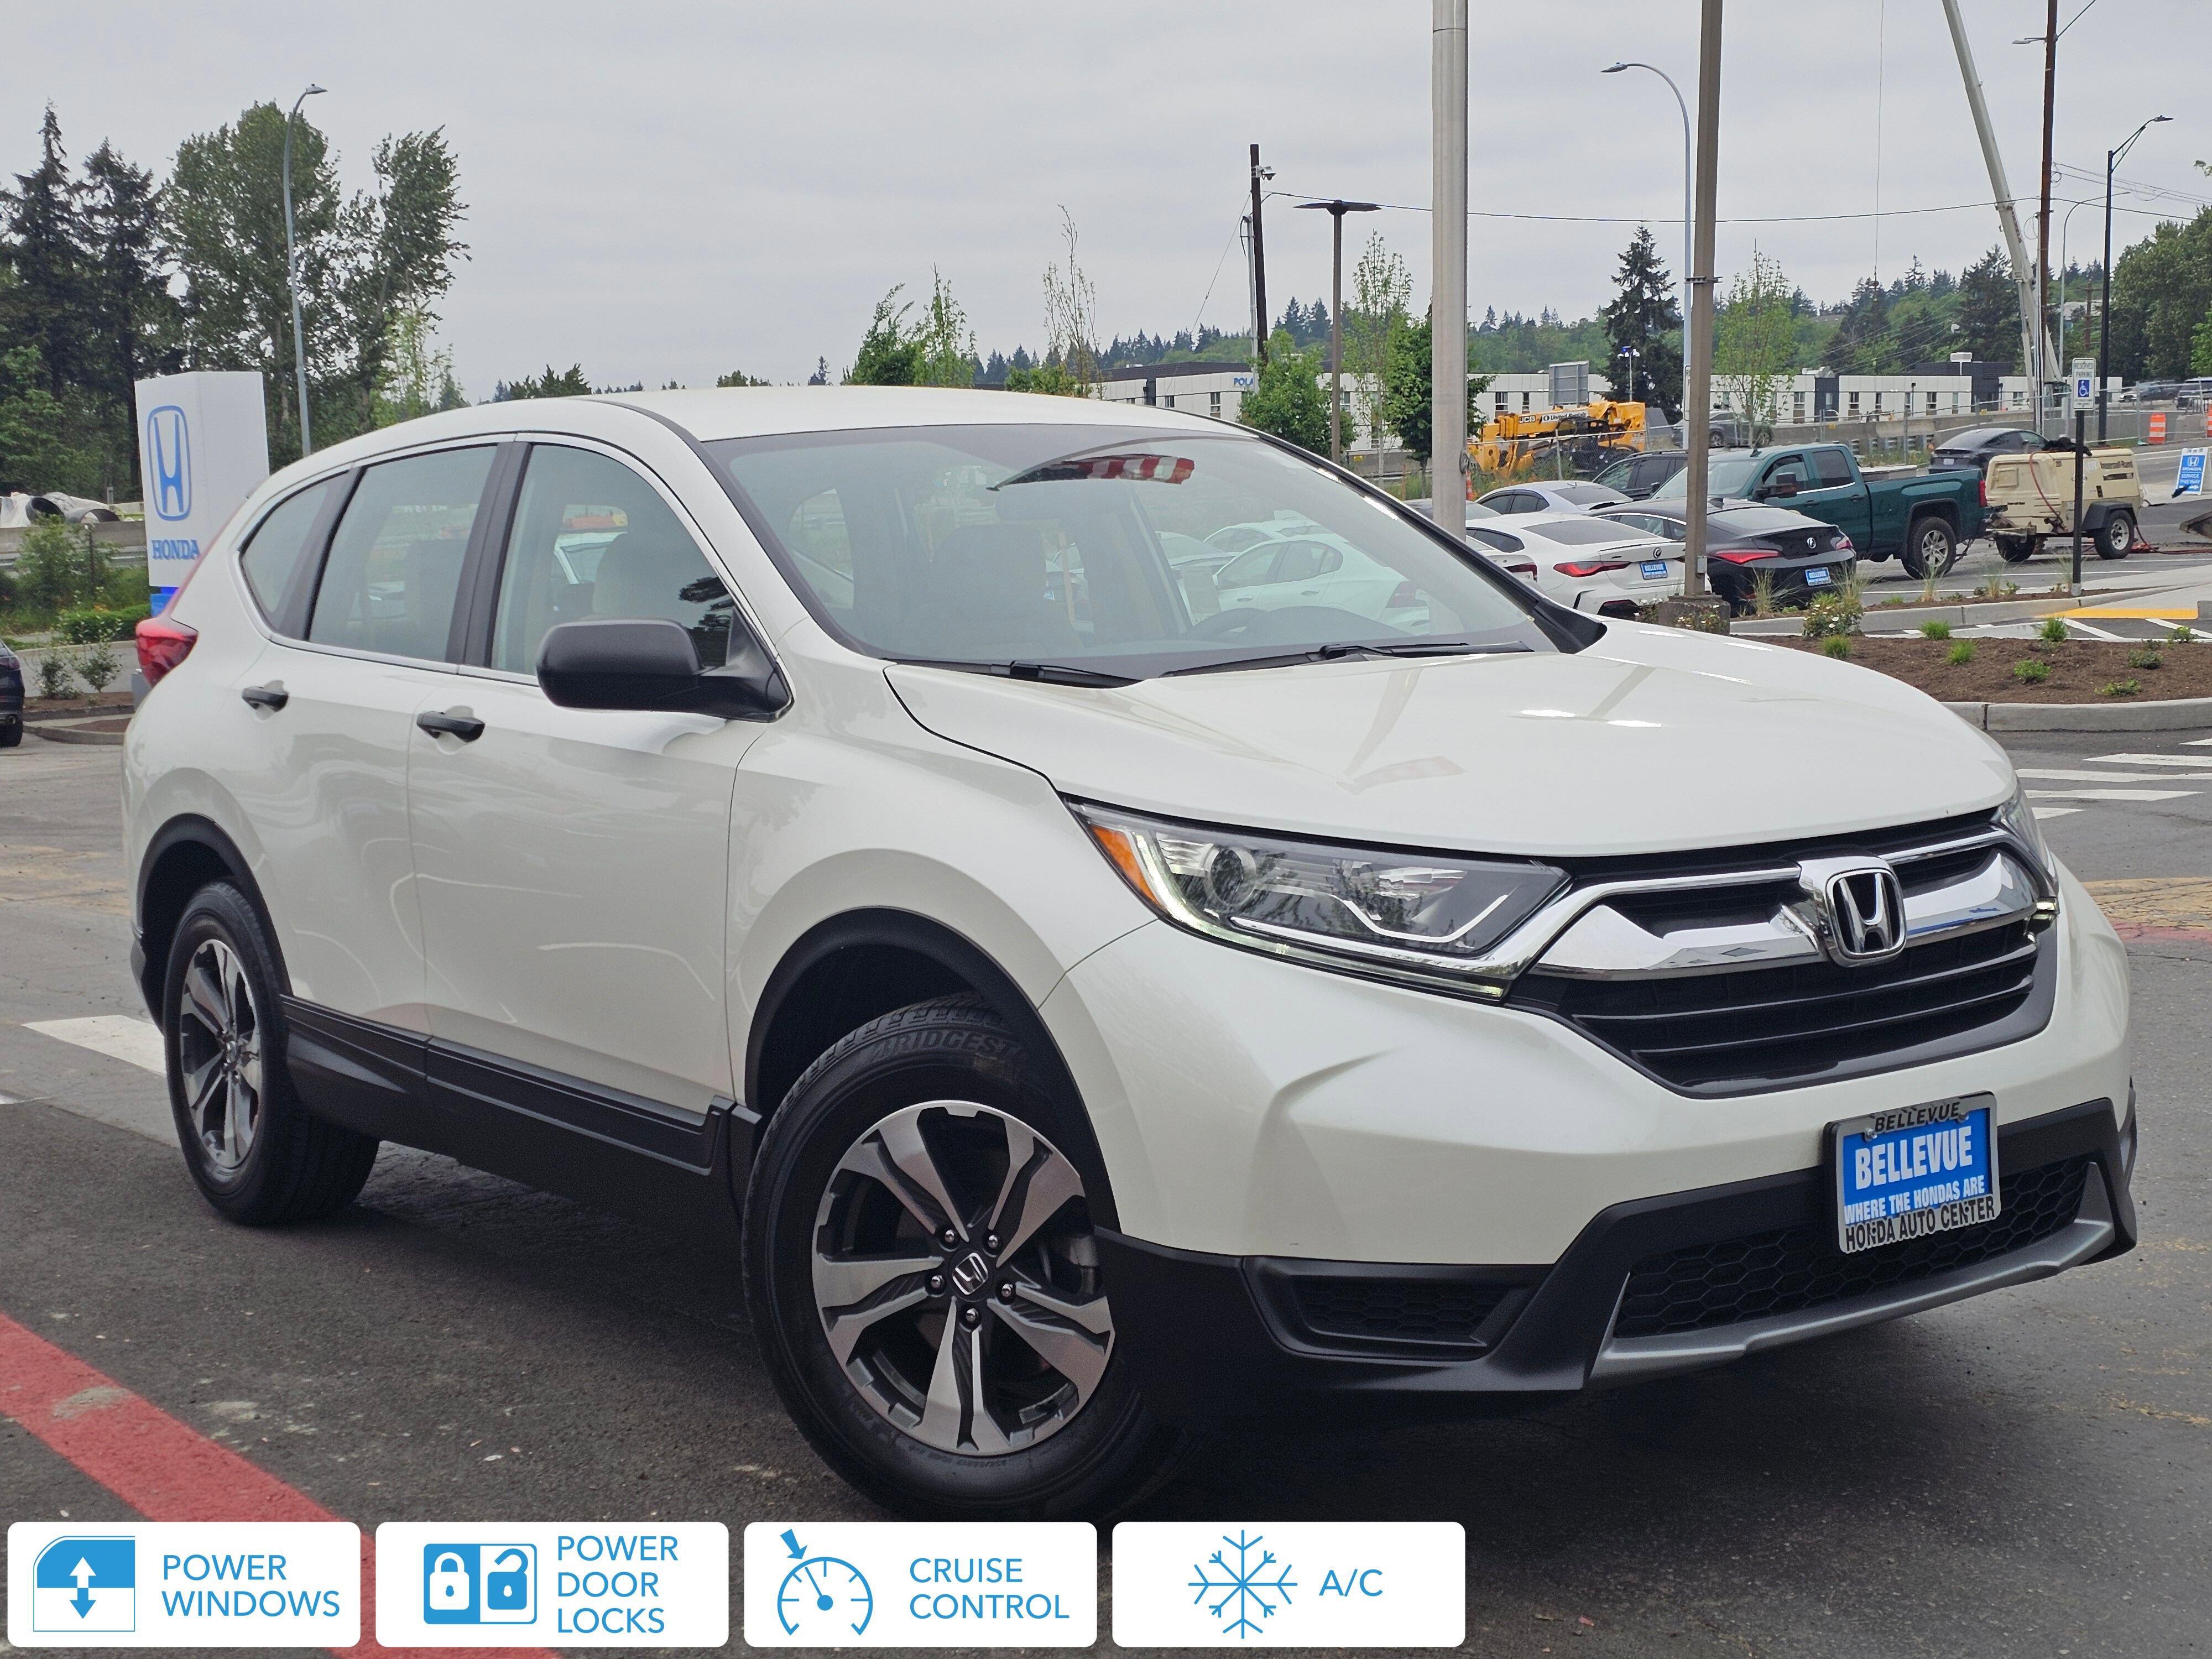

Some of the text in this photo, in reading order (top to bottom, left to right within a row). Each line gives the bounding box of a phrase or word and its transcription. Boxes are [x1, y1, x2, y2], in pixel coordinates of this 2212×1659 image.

[152, 539, 201, 560] HONDA
[1875, 1102, 1960, 1133] BELLEVUE
[1855, 1126, 1973, 1190] BELLEVUE
[1844, 1175, 1985, 1225] WHERE THE HONDAS ARE
[1846, 1197, 1995, 1251] HONDA AUTO CENTER
